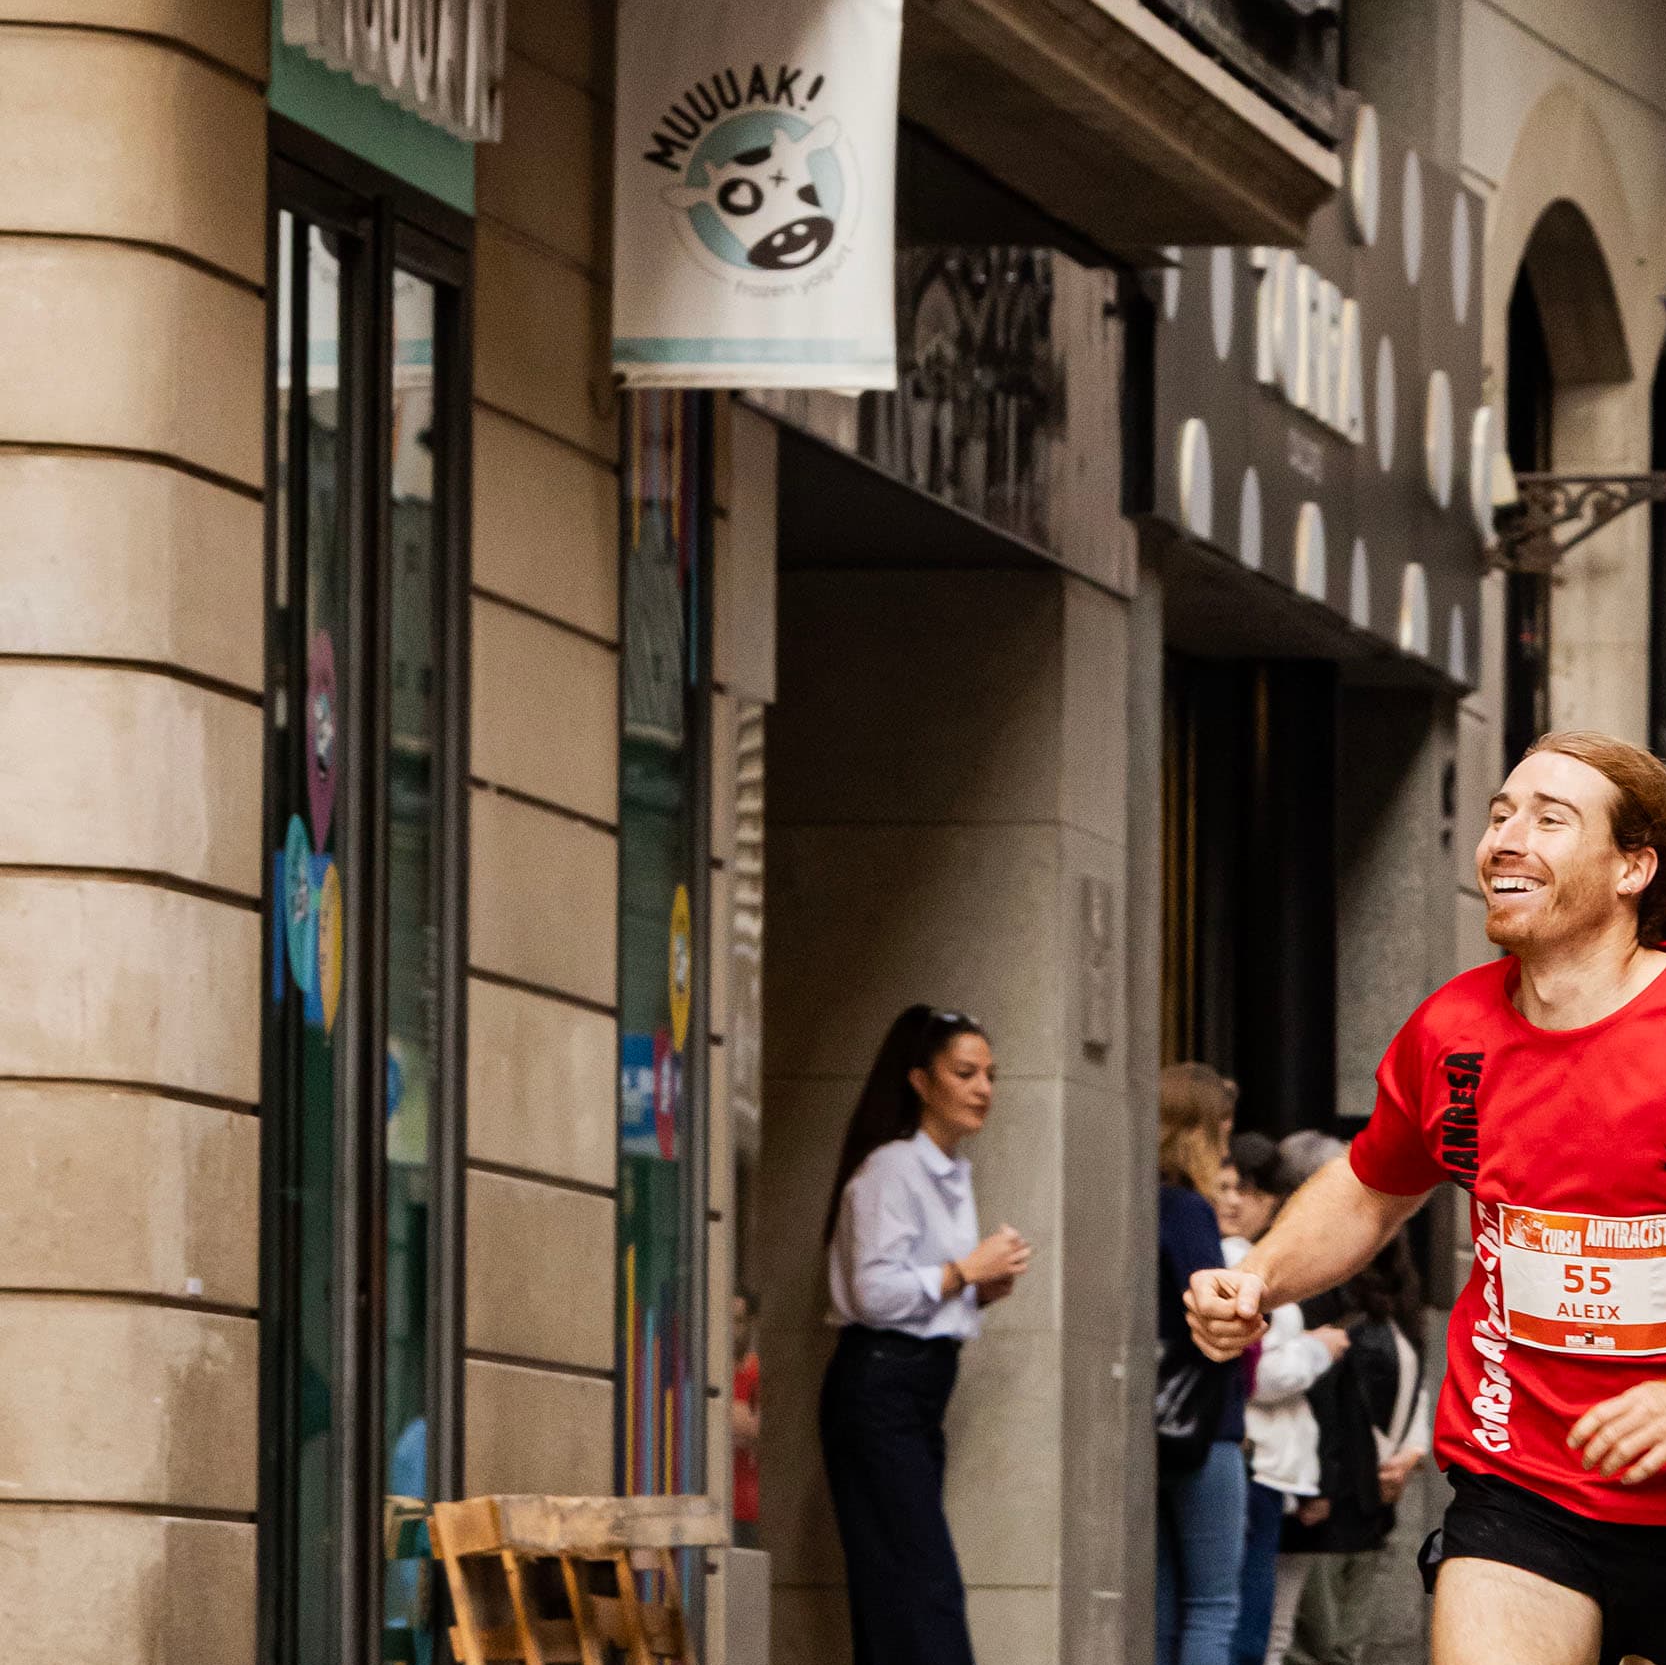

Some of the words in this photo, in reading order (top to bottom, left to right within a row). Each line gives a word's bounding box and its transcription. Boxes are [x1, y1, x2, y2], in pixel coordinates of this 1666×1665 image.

[643, 62, 825, 173] MUUUAK!
[1541, 1227, 1582, 1256] CURSA
[1563, 1264, 1612, 1295] 55
[1556, 1302, 1621, 1320] ALEIX
